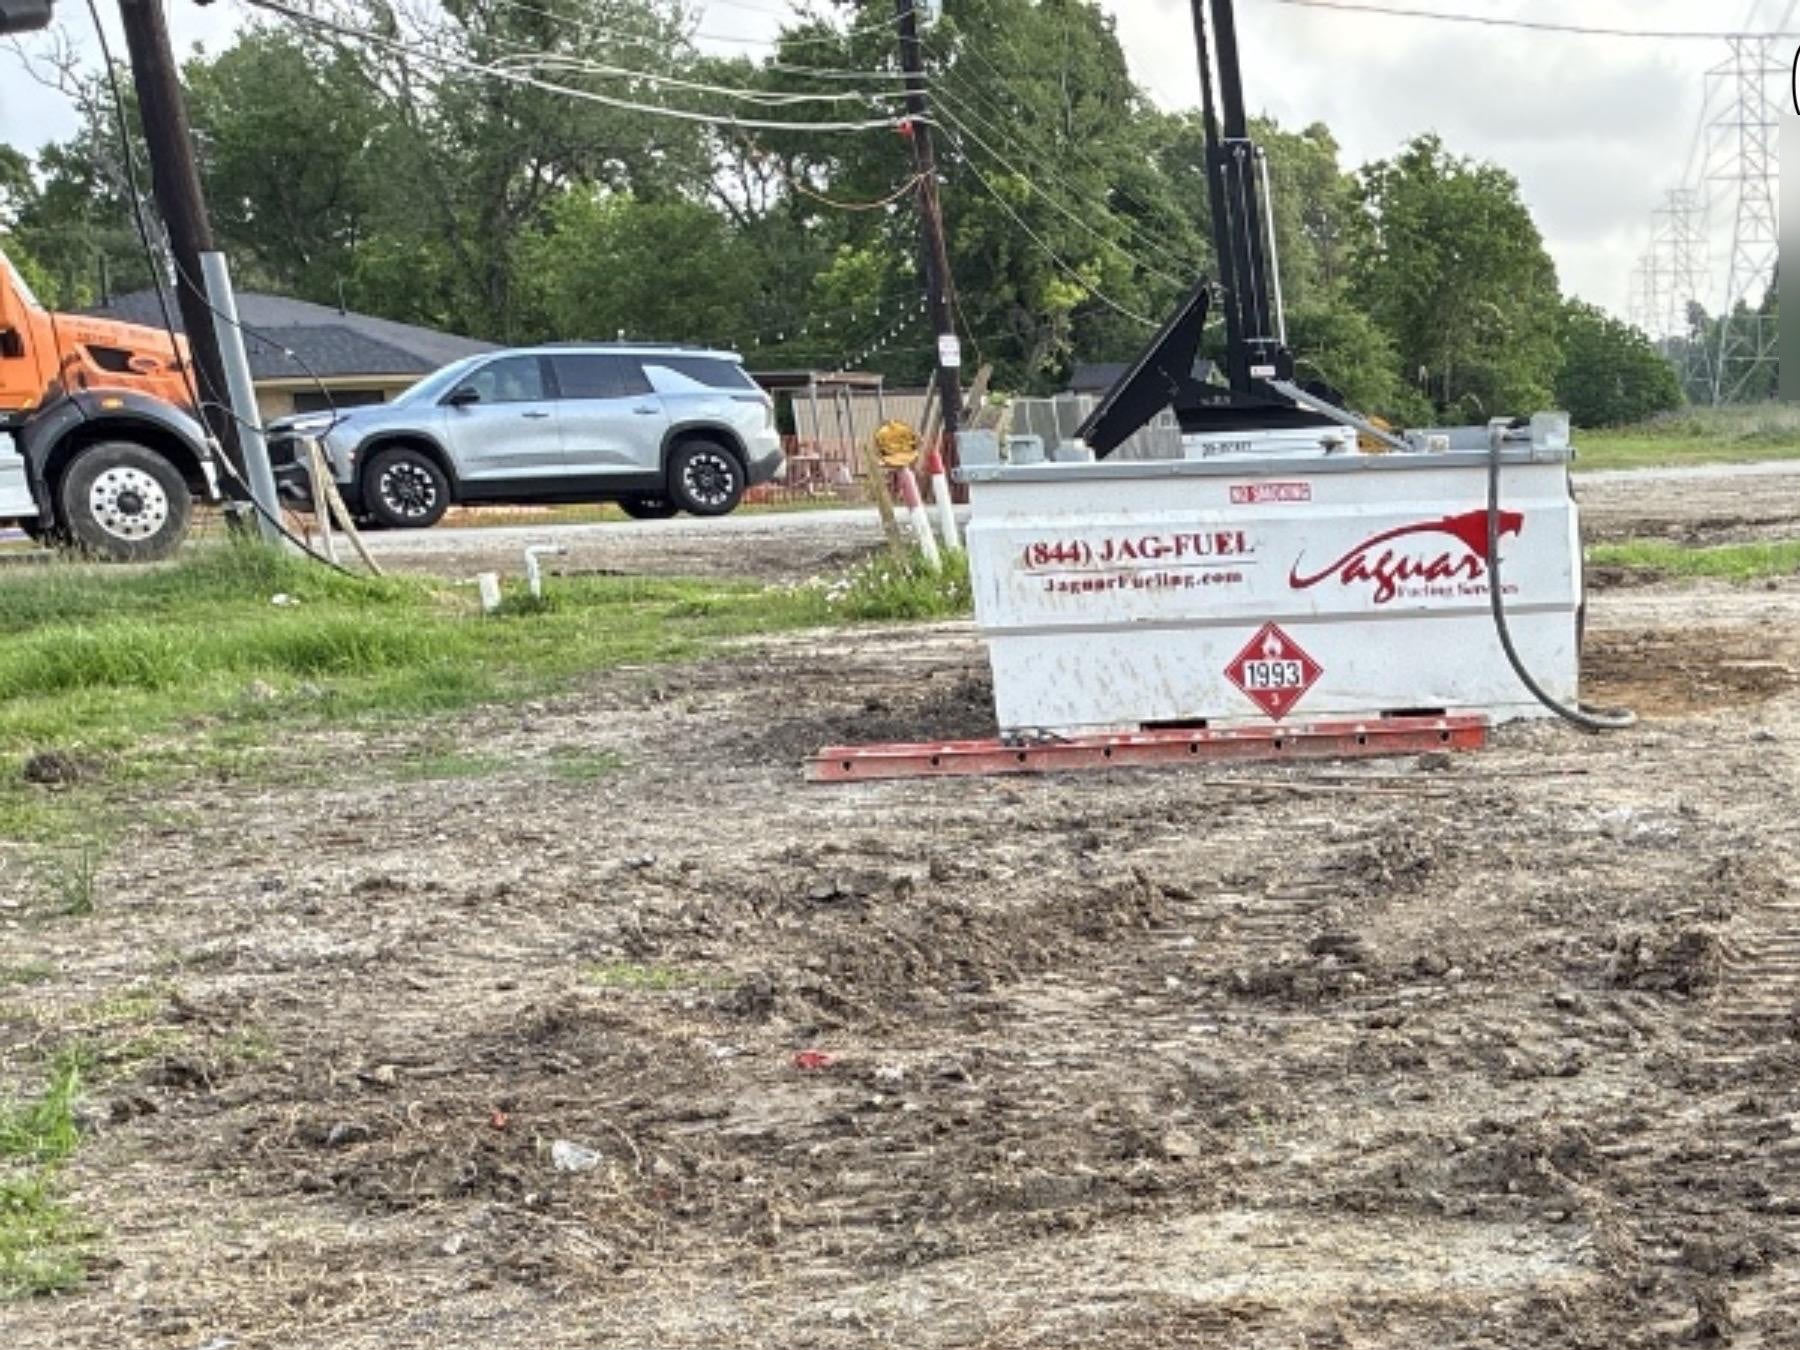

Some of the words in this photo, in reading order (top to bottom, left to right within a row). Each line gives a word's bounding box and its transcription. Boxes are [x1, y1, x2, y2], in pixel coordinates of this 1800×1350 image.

[1024, 539, 1092, 569] (844)
[1099, 530, 1255, 562] JAG-FUEL
[1044, 570, 1242, 594] JaguarFueling.com
[1247, 662, 1300, 687] 1993
